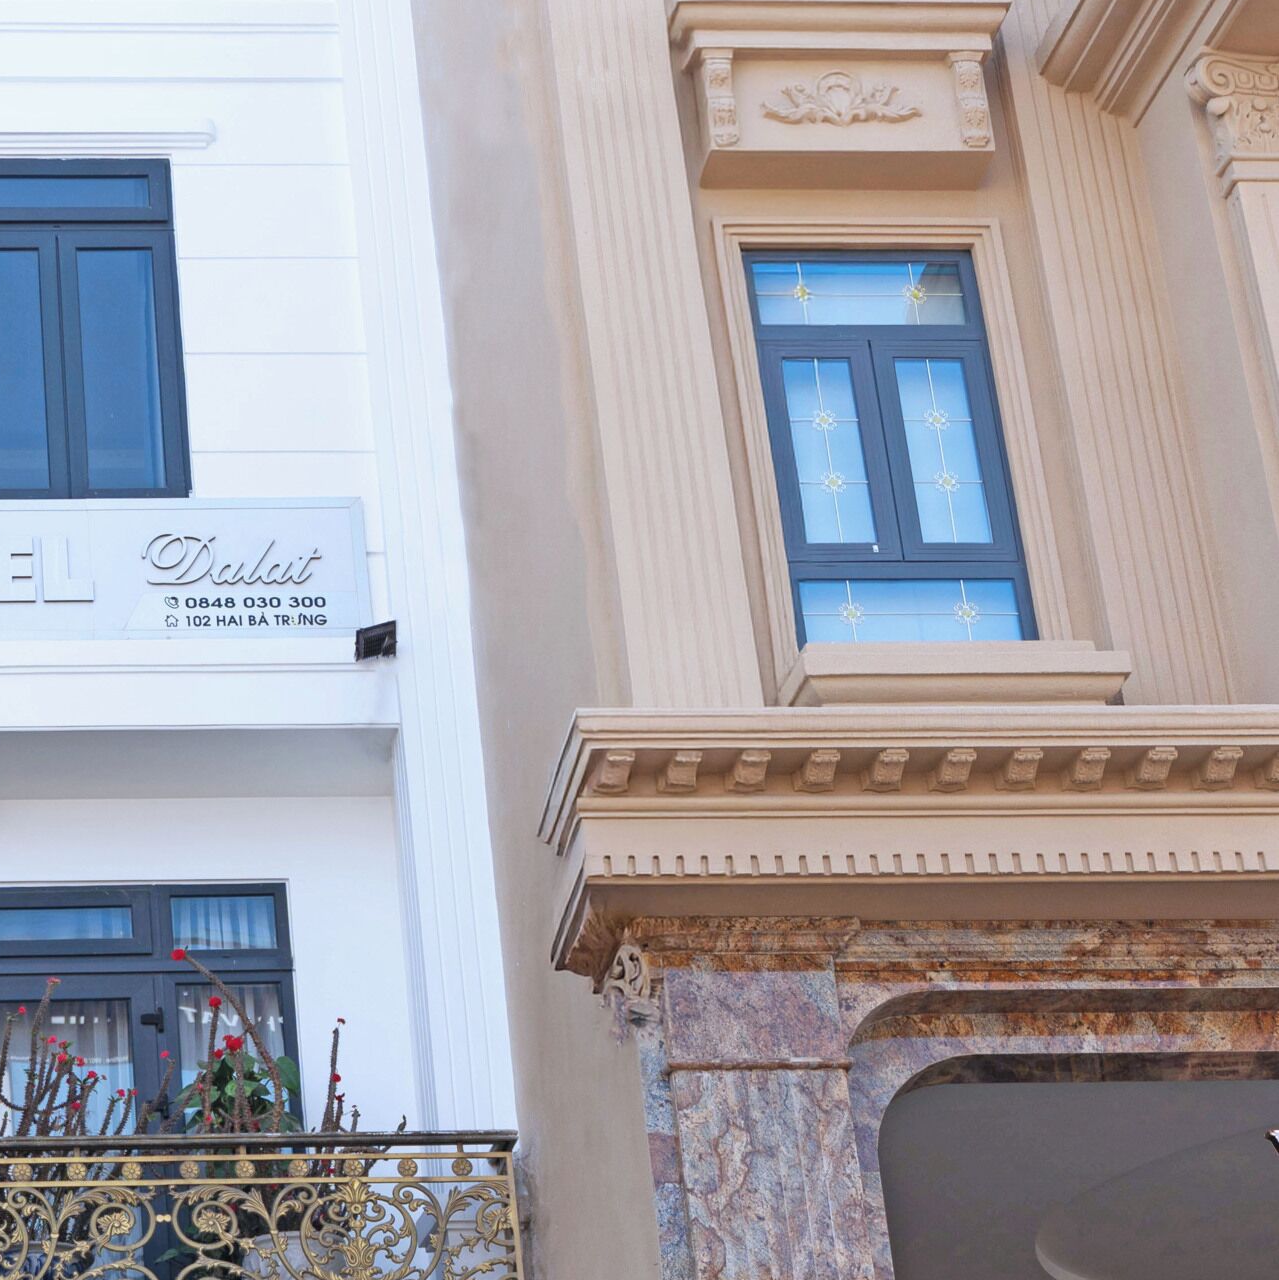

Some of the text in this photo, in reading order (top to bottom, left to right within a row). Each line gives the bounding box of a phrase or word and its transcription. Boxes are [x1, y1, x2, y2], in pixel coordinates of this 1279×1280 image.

[184, 596, 327, 609] 0848 030 300
[186, 615, 212, 628] 102
[216, 614, 243, 627] HAI
